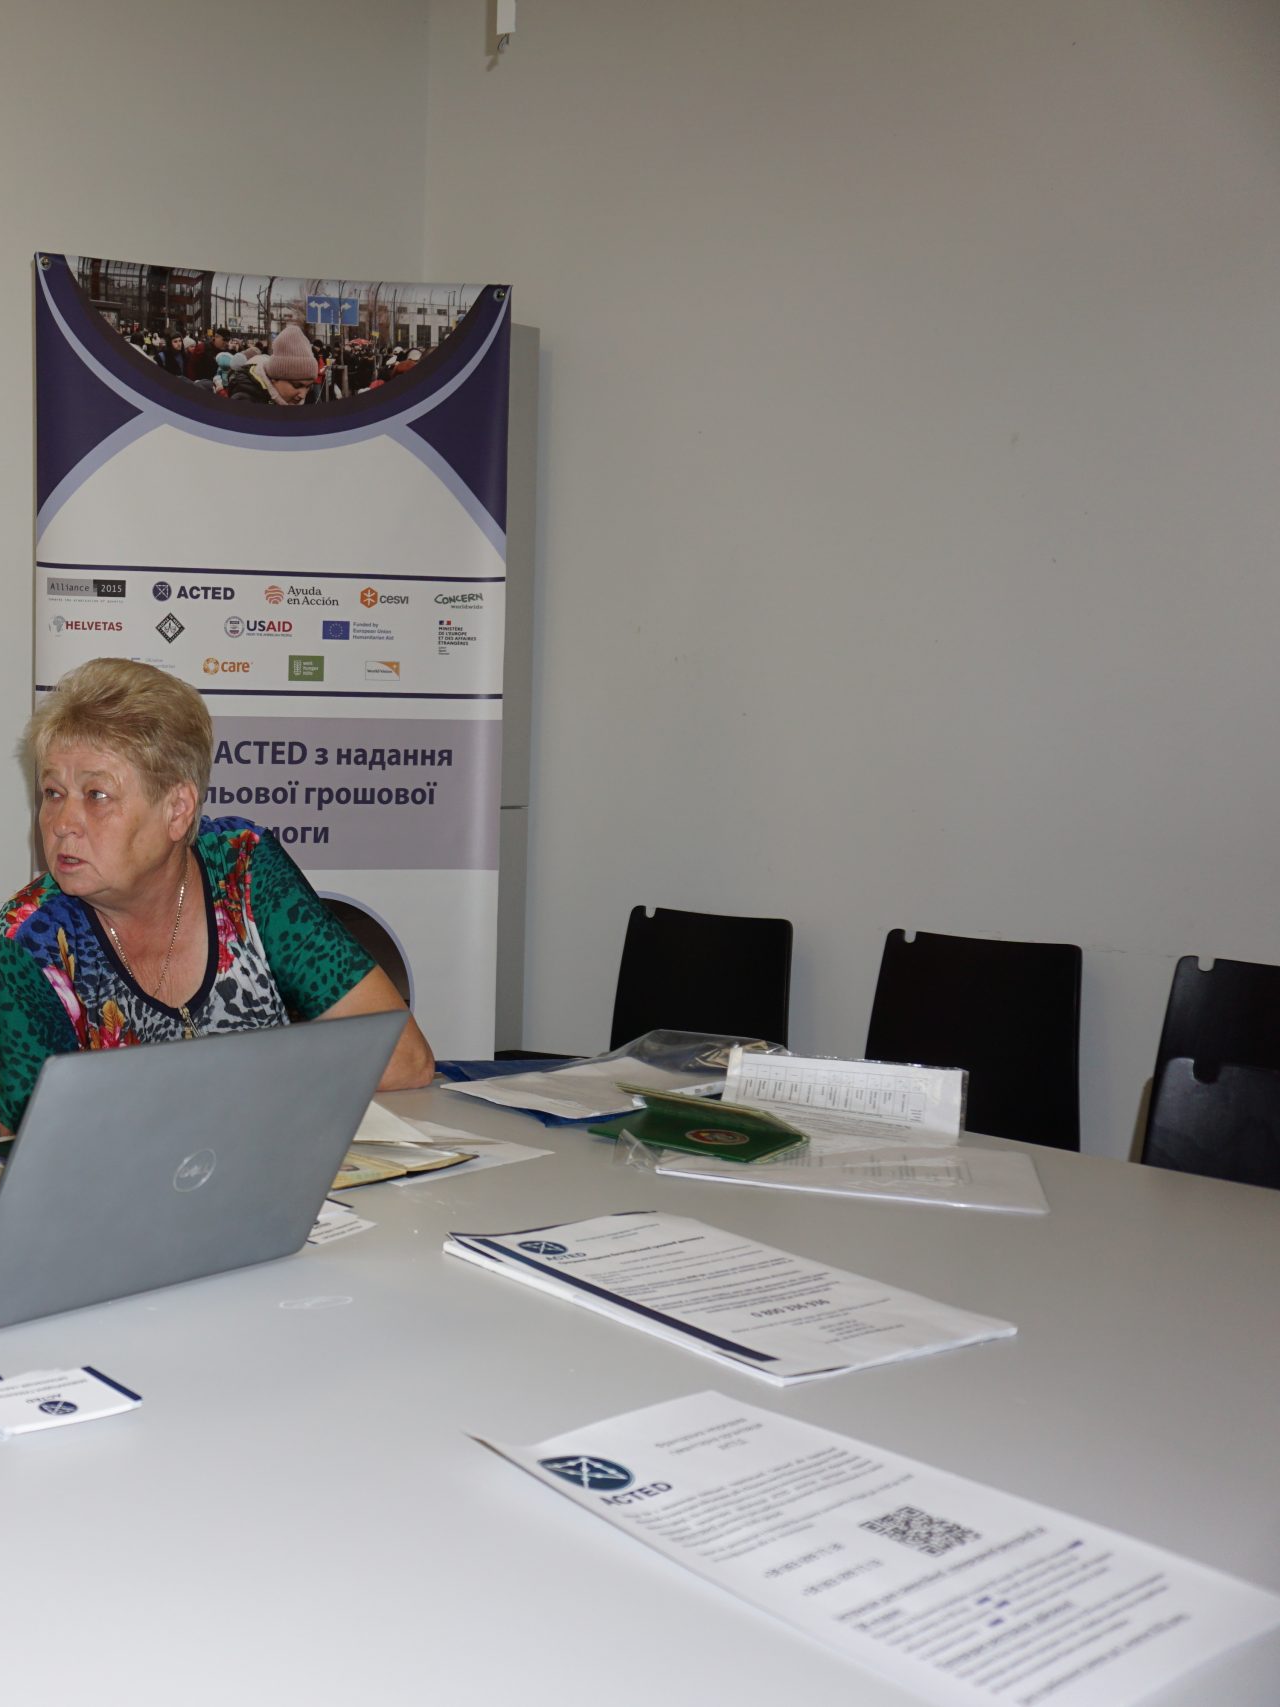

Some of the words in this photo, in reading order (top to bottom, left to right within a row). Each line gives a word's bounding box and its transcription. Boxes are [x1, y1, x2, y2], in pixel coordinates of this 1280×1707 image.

[50, 582, 90, 592] Alliance
[101, 584, 122, 593] 2015
[177, 585, 235, 600] ACTED
[287, 585, 322, 596] Ayuda
[287, 597, 300, 605] en
[301, 596, 339, 606] Acción
[379, 594, 409, 604] cesvi
[65, 621, 123, 632] HELVETAS
[246, 619, 293, 633] USAID
[221, 660, 250, 673] care
[214, 740, 308, 765] ACTED
[315, 747, 329, 765] з
[336, 747, 453, 771] надання
[304, 781, 438, 811] грошової
[546, 1251, 588, 1262] ACTED
[600, 1481, 674, 1506] ACTED
